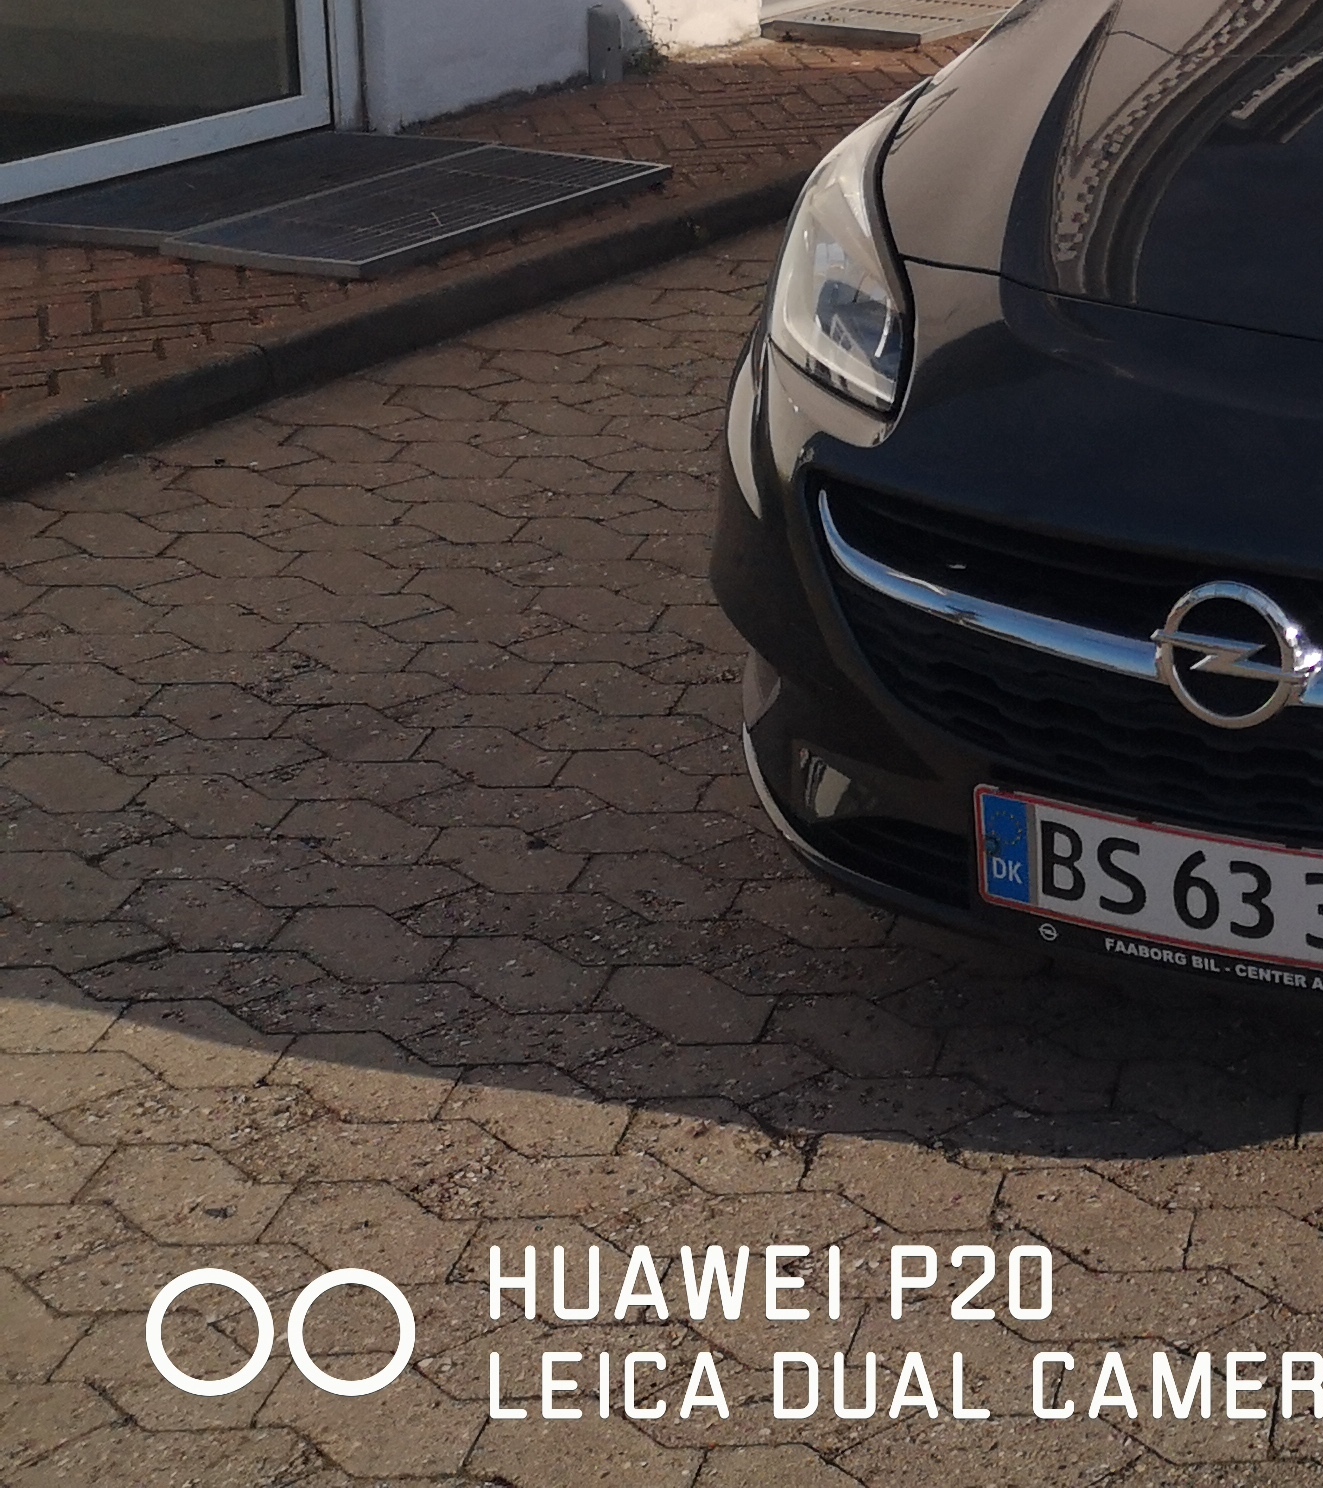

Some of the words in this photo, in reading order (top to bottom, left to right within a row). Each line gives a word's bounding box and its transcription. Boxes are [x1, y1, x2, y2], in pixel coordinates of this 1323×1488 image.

[992, 856, 1022, 884] DK
[1041, 820, 1147, 914] BS
[1173, 850, 1275, 939] 63
[1105, 938, 1187, 966] FAABORG
[1192, 955, 1220, 973] BIL
[1235, 964, 1307, 989] CENTER
